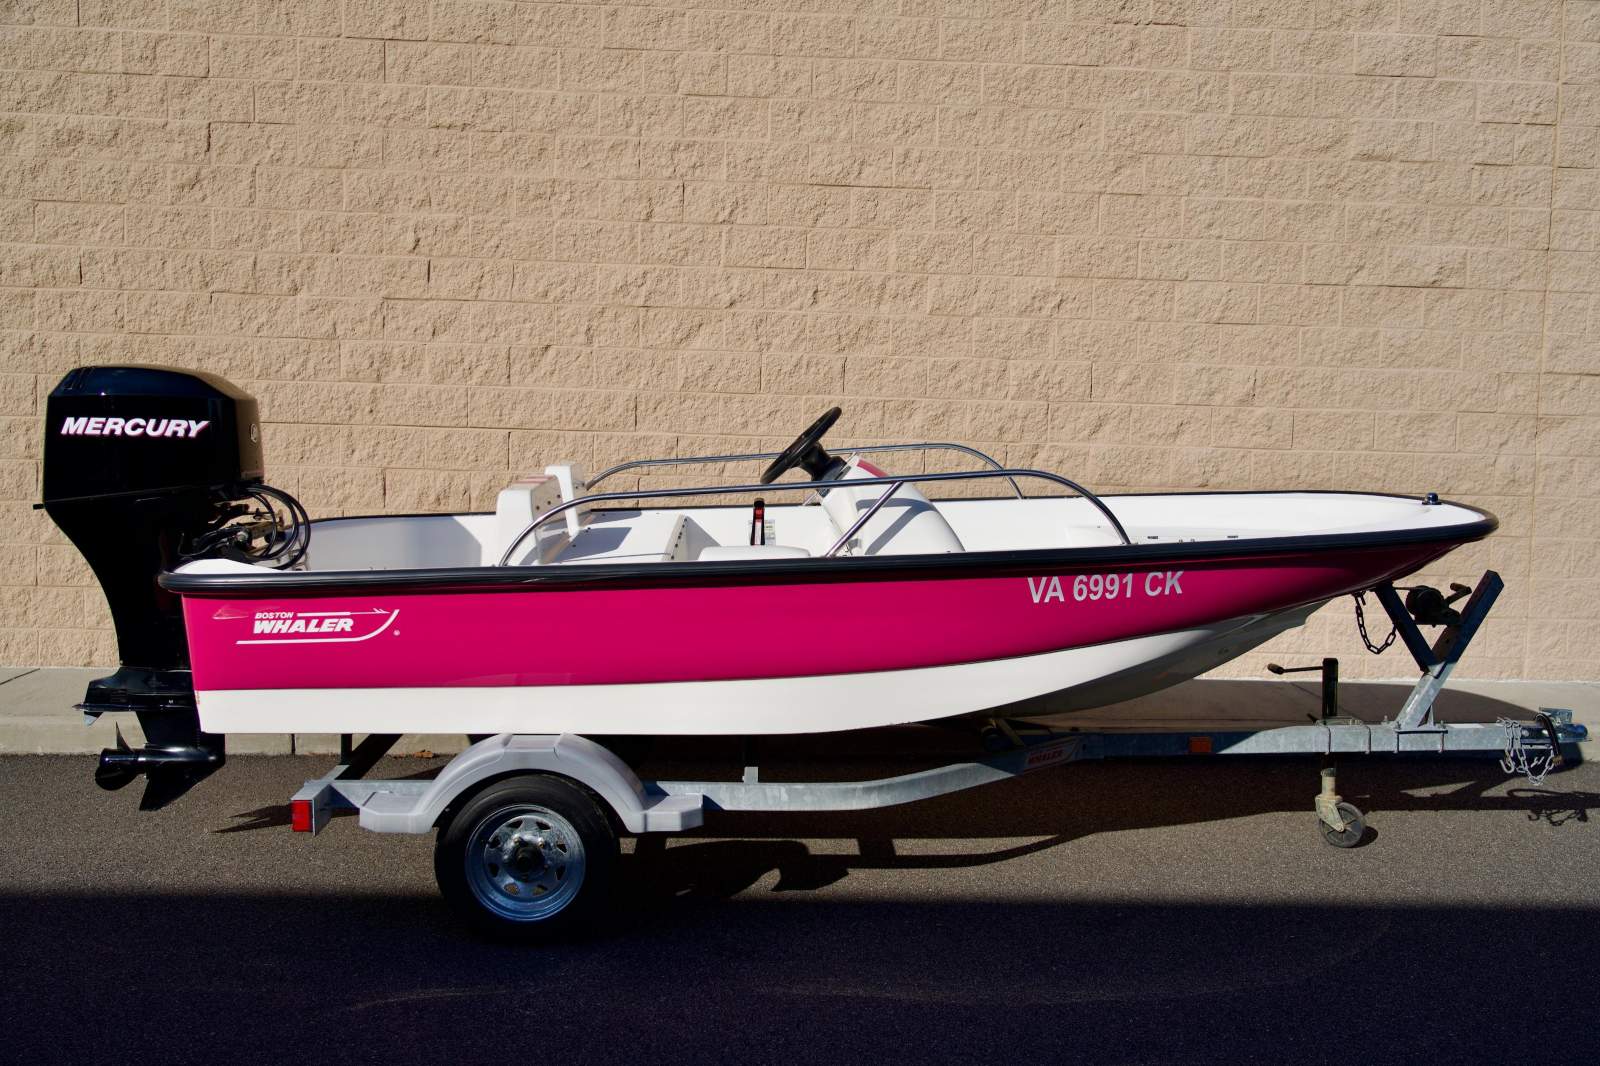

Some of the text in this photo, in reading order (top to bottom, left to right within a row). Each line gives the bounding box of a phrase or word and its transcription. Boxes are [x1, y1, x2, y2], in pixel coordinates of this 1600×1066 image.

[60, 416, 210, 438] MERCURY
[1027, 570, 1184, 603] VA 6991 CK
[254, 611, 294, 620] BOSTON
[253, 618, 354, 634] WHALER
